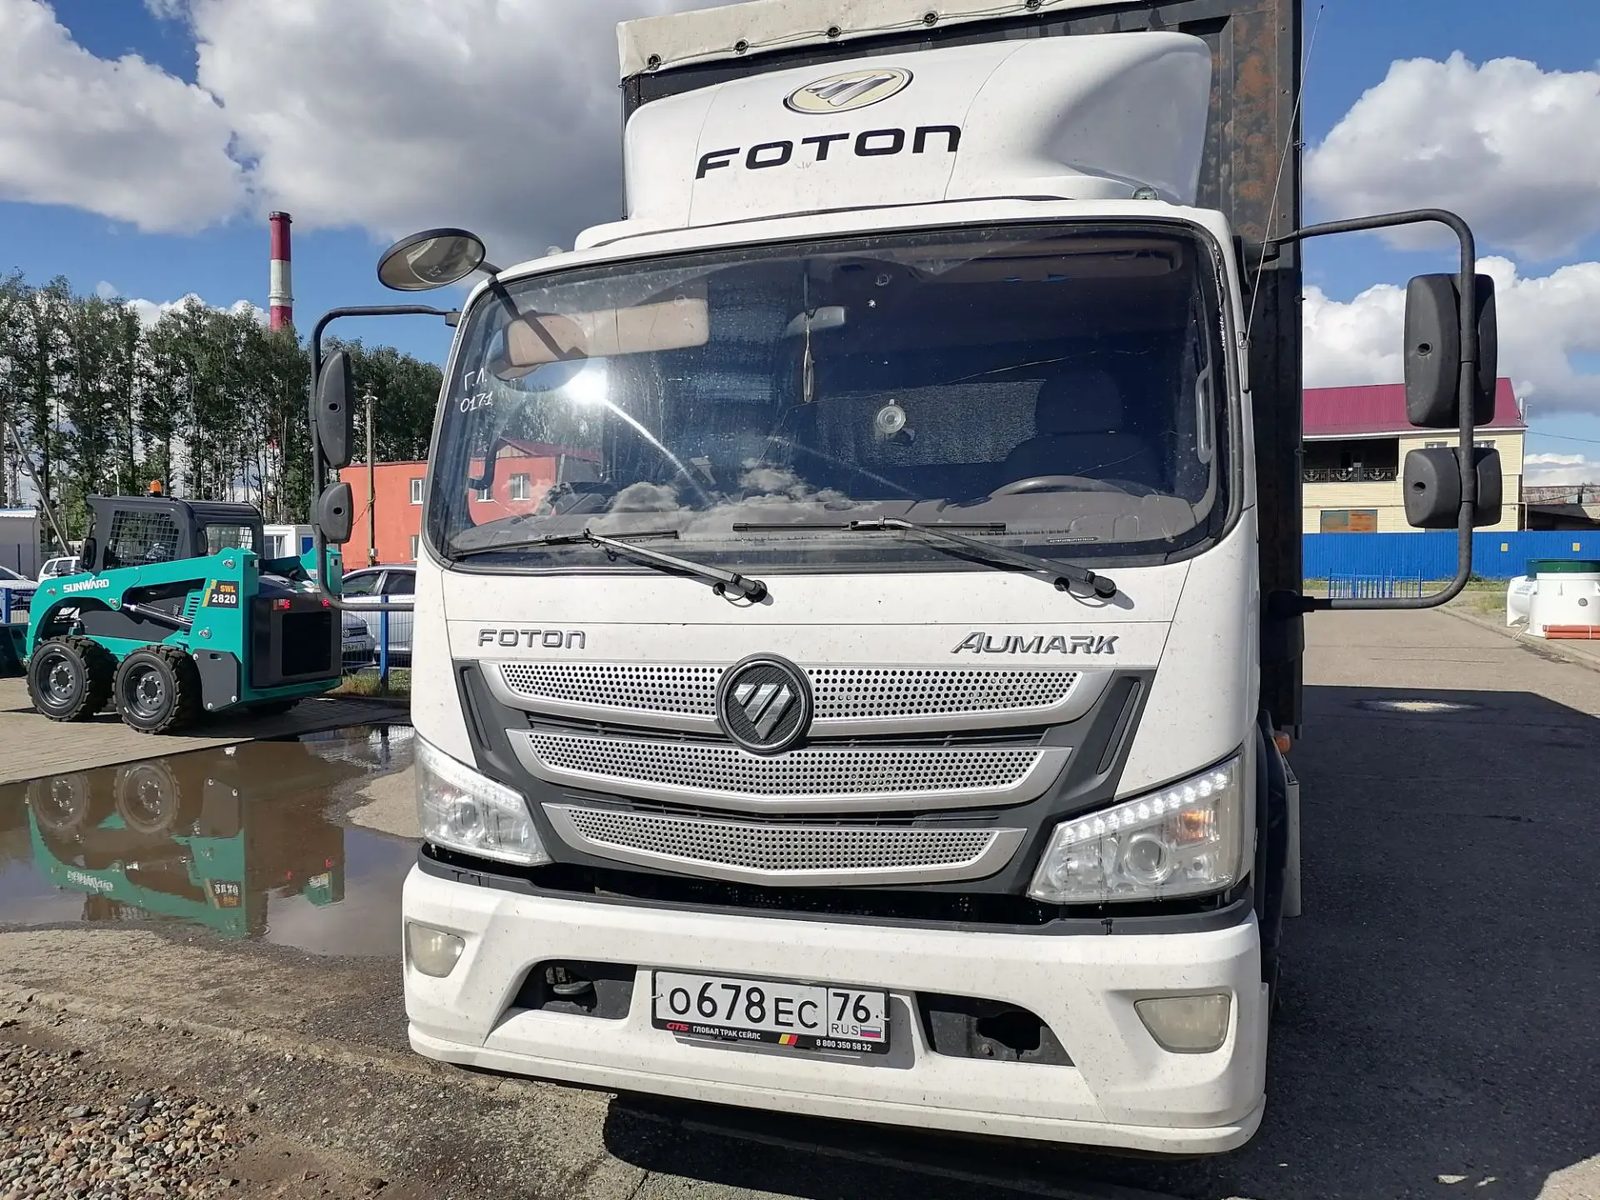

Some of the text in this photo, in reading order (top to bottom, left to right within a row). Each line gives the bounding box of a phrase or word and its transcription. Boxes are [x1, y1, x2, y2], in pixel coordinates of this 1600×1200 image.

[695, 124, 962, 180] FOTON
[63, 576, 110, 594] SUNWARD
[211, 593, 237, 604] 2820
[477, 628, 586, 650] FOTON
[950, 631, 1120, 655] AUMARK
[832, 992, 871, 1024] 76
[692, 1025, 761, 1040] ГЛОБАЛ ТРАК СЕЙЛС
[831, 1023, 859, 1036] RUS
[822, 1039, 836, 1048] 800
